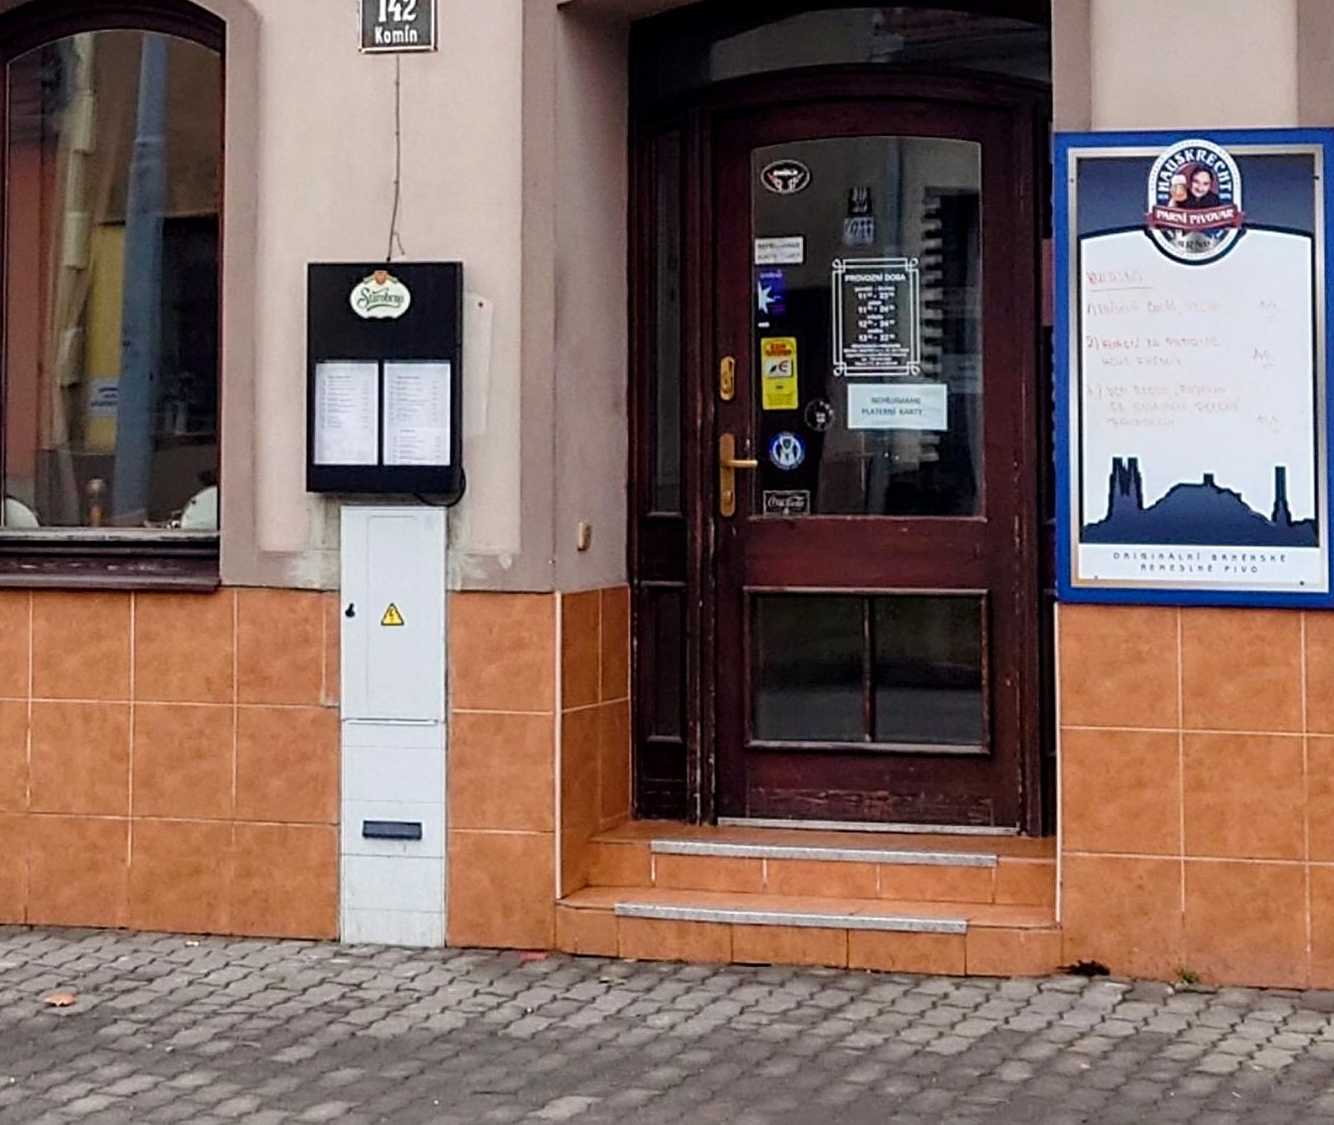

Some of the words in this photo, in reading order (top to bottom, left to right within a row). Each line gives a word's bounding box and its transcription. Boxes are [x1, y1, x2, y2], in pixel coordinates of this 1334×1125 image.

[374, 25, 418, 44] Komín
[1157, 148, 1232, 192] HAUSKRECHT
[356, 287, 404, 311] Starobrno
[1224, 565, 1258, 574] PIVO
